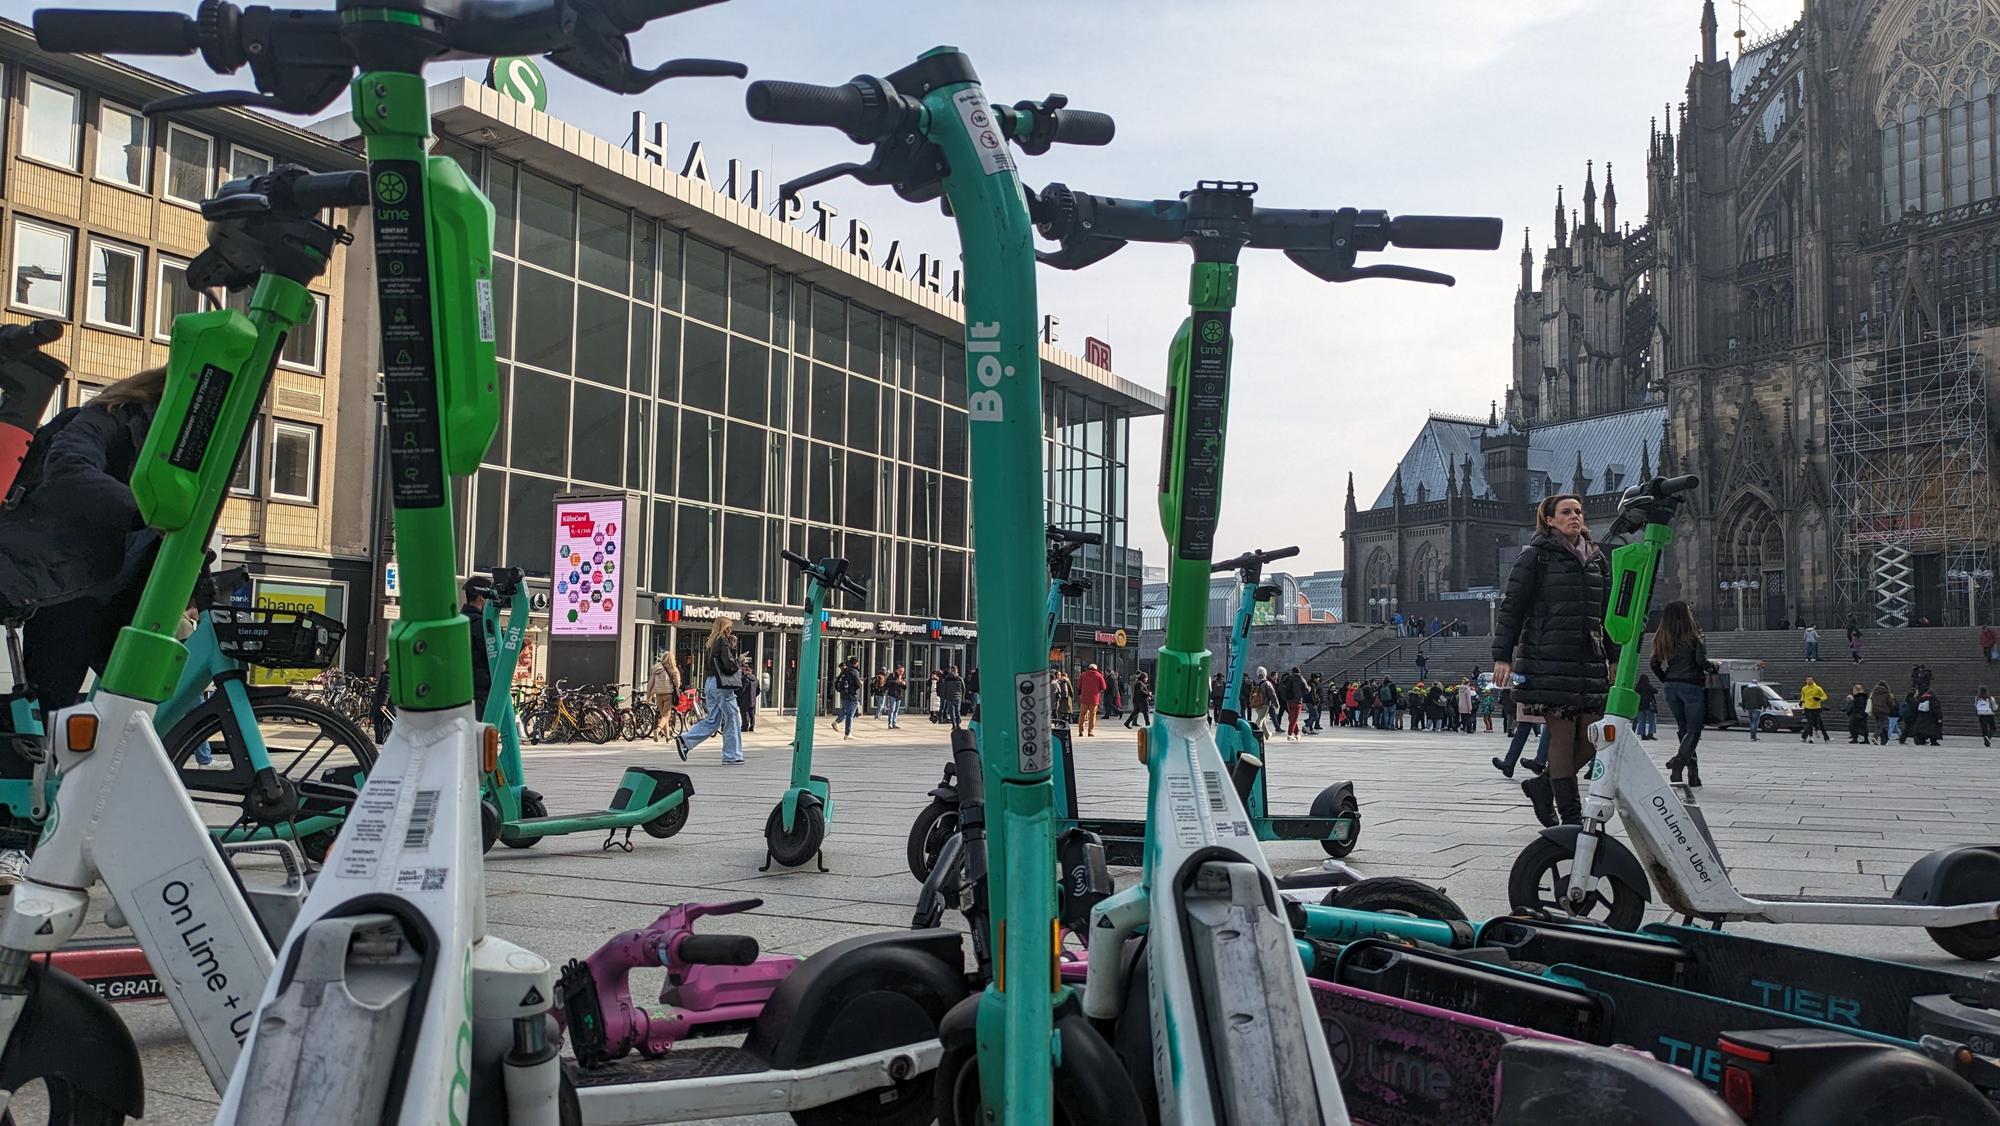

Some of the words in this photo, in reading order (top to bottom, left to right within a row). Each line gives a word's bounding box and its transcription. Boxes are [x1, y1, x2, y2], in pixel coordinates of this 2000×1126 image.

[503, 59, 539, 109] S
[1091, 342, 1109, 372] DB
[967, 321, 1016, 422] Bolt
[256, 596, 315, 614] Change
[685, 604, 741, 621] NetCologne
[766, 610, 804, 627] Highspee
[831, 616, 874, 631] NetCologne
[893, 621, 927, 635] Highspeed
[238, 627, 269, 636] tier.app
[505, 626, 521, 651] Bolt
[486, 637, 499, 658] Bolt
[1652, 796, 1668, 816] On
[1664, 814, 1687, 845] Lime
[1689, 852, 1712, 884] Uber
[162, 880, 193, 926] On
[181, 922, 228, 993] Lime
[223, 995, 241, 1010] +
[1751, 979, 1861, 1026] TIER
[1658, 1035, 1722, 1083] TIE
